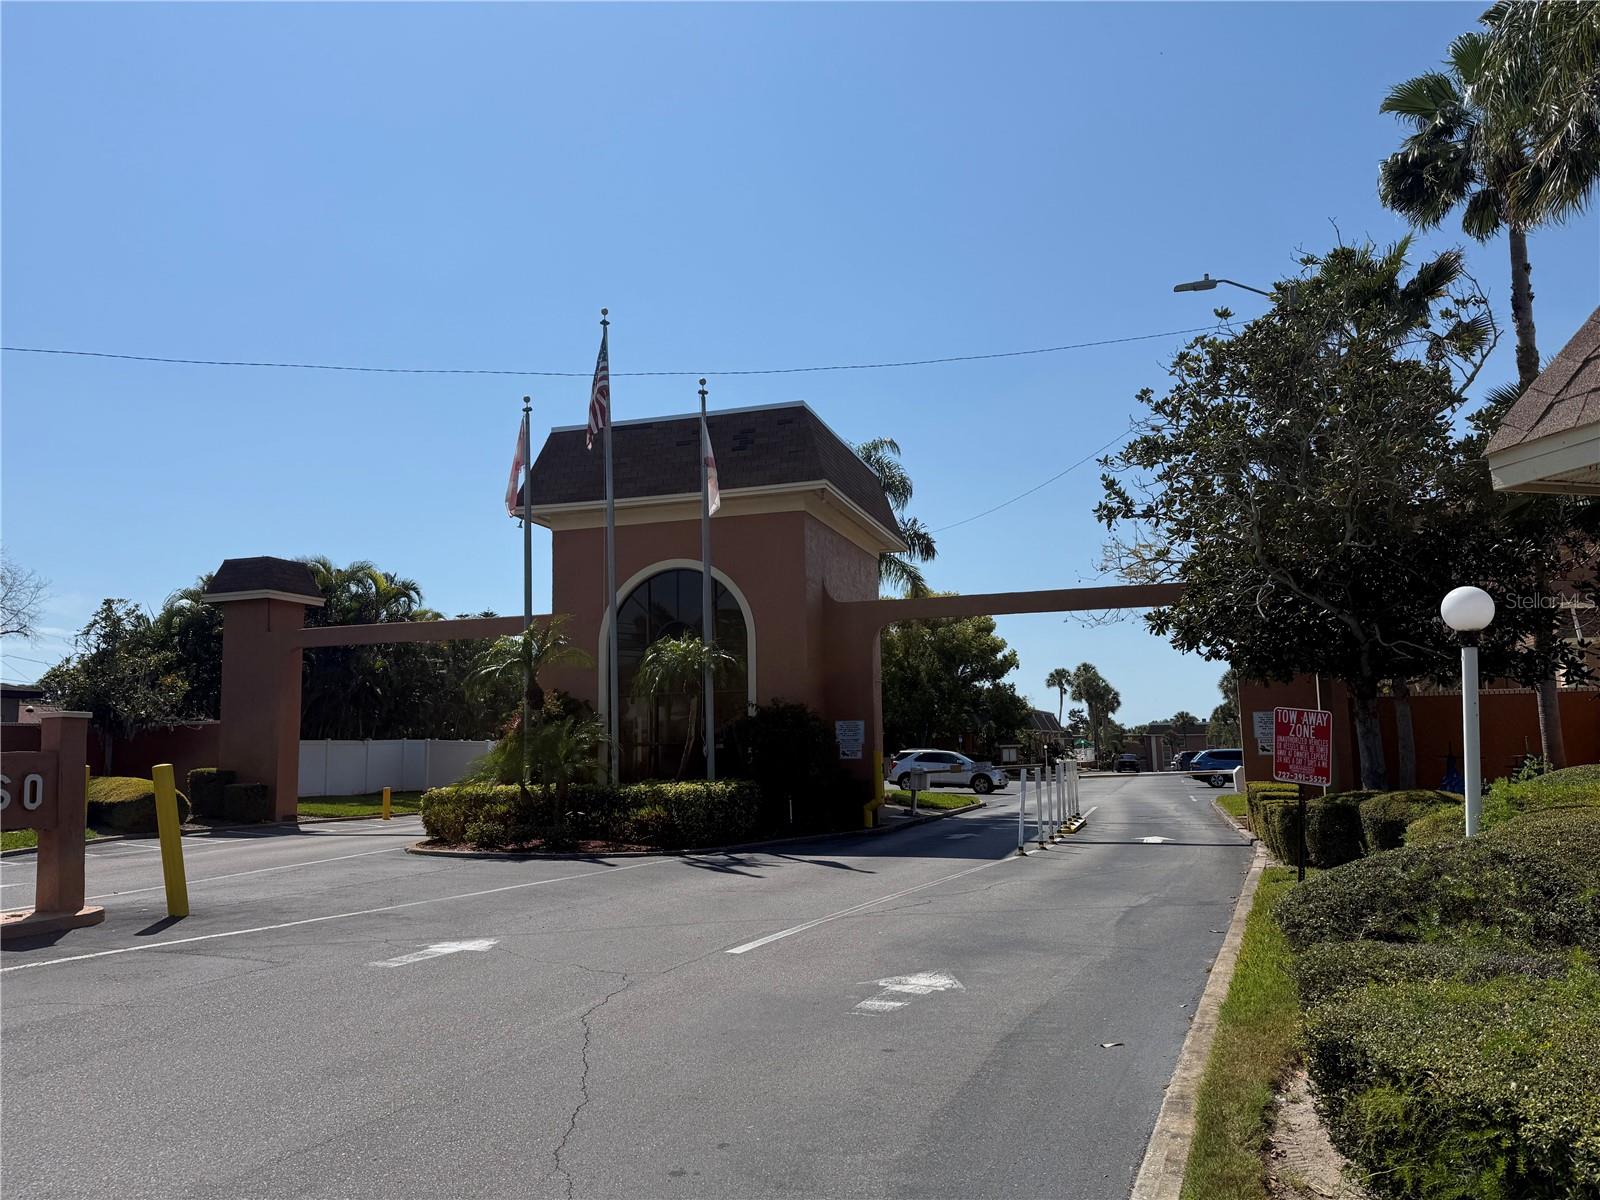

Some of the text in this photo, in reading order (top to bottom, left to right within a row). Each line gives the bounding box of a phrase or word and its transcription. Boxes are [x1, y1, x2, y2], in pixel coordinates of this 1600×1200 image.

[1277, 709, 1297, 724] TOW
[1302, 711, 1329, 727] AWAY
[1289, 723, 1316, 739] ZONE
[1276, 735, 1329, 747] UNAUTHORIZED VEHICLES
[1310, 752, 1328, 762] EXPENSE
[1277, 771, 1327, 783] 727-391-5522
